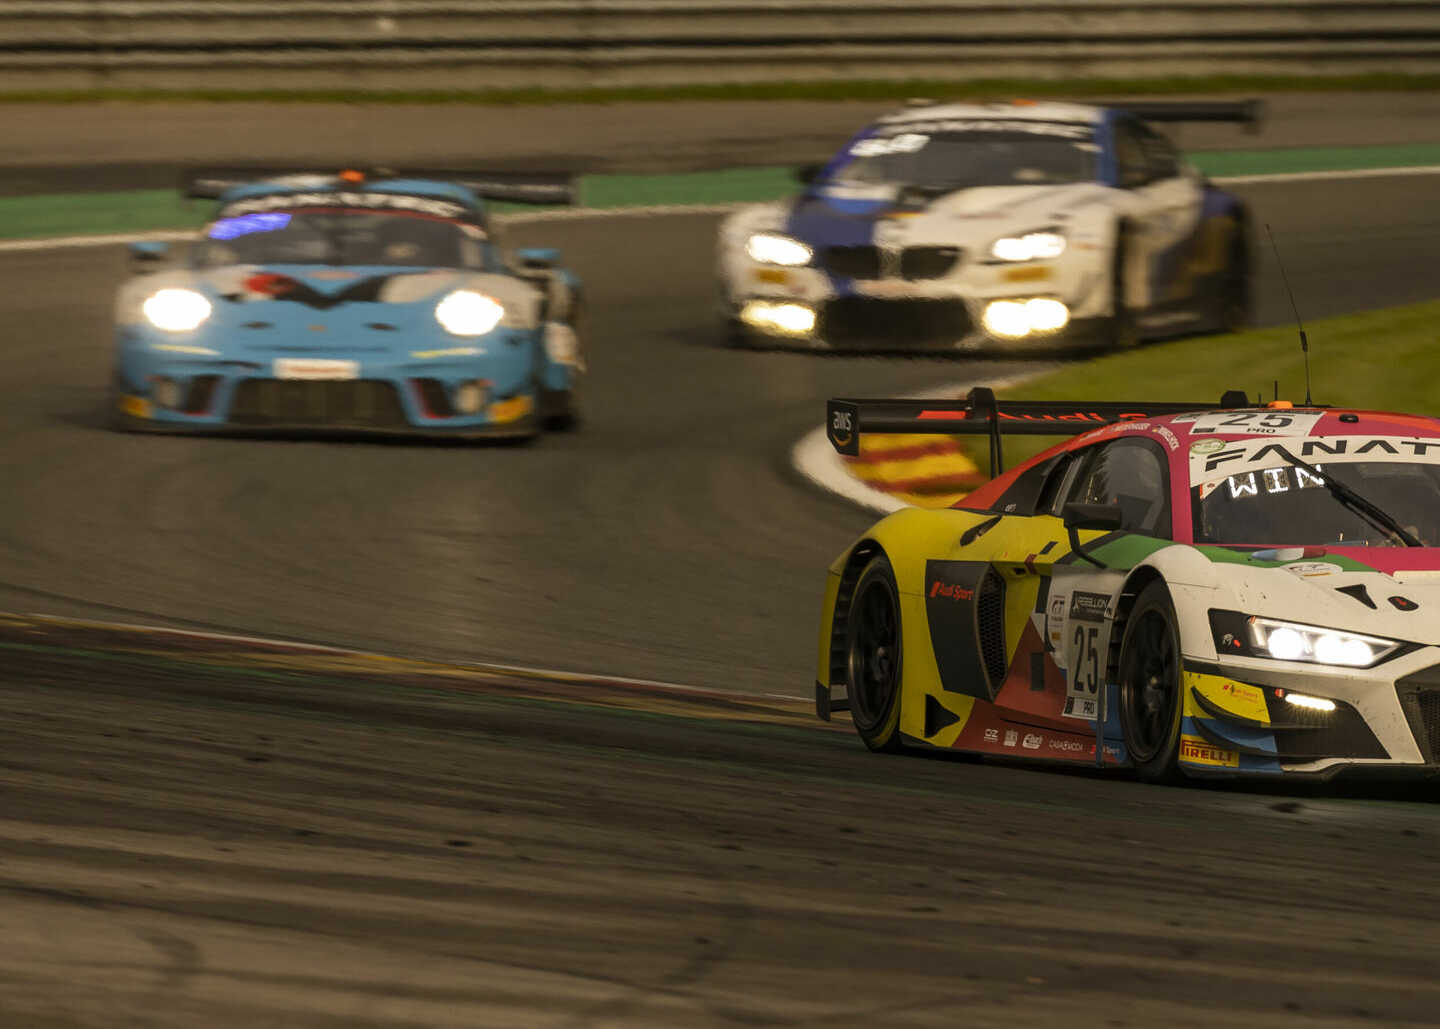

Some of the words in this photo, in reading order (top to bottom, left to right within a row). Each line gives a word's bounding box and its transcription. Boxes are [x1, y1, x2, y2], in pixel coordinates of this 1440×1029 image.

[833, 411, 852, 430] aws
[1219, 412, 1295, 428] 25
[1228, 464, 1326, 499] WIN
[939, 582, 954, 597] Audi
[953, 584, 974, 601] Sport
[1074, 625, 1099, 694] 25
[1083, 701, 1095, 715] PRO
[984, 728, 999, 738] OZ
[1180, 739, 1233, 762] PIRELLI
